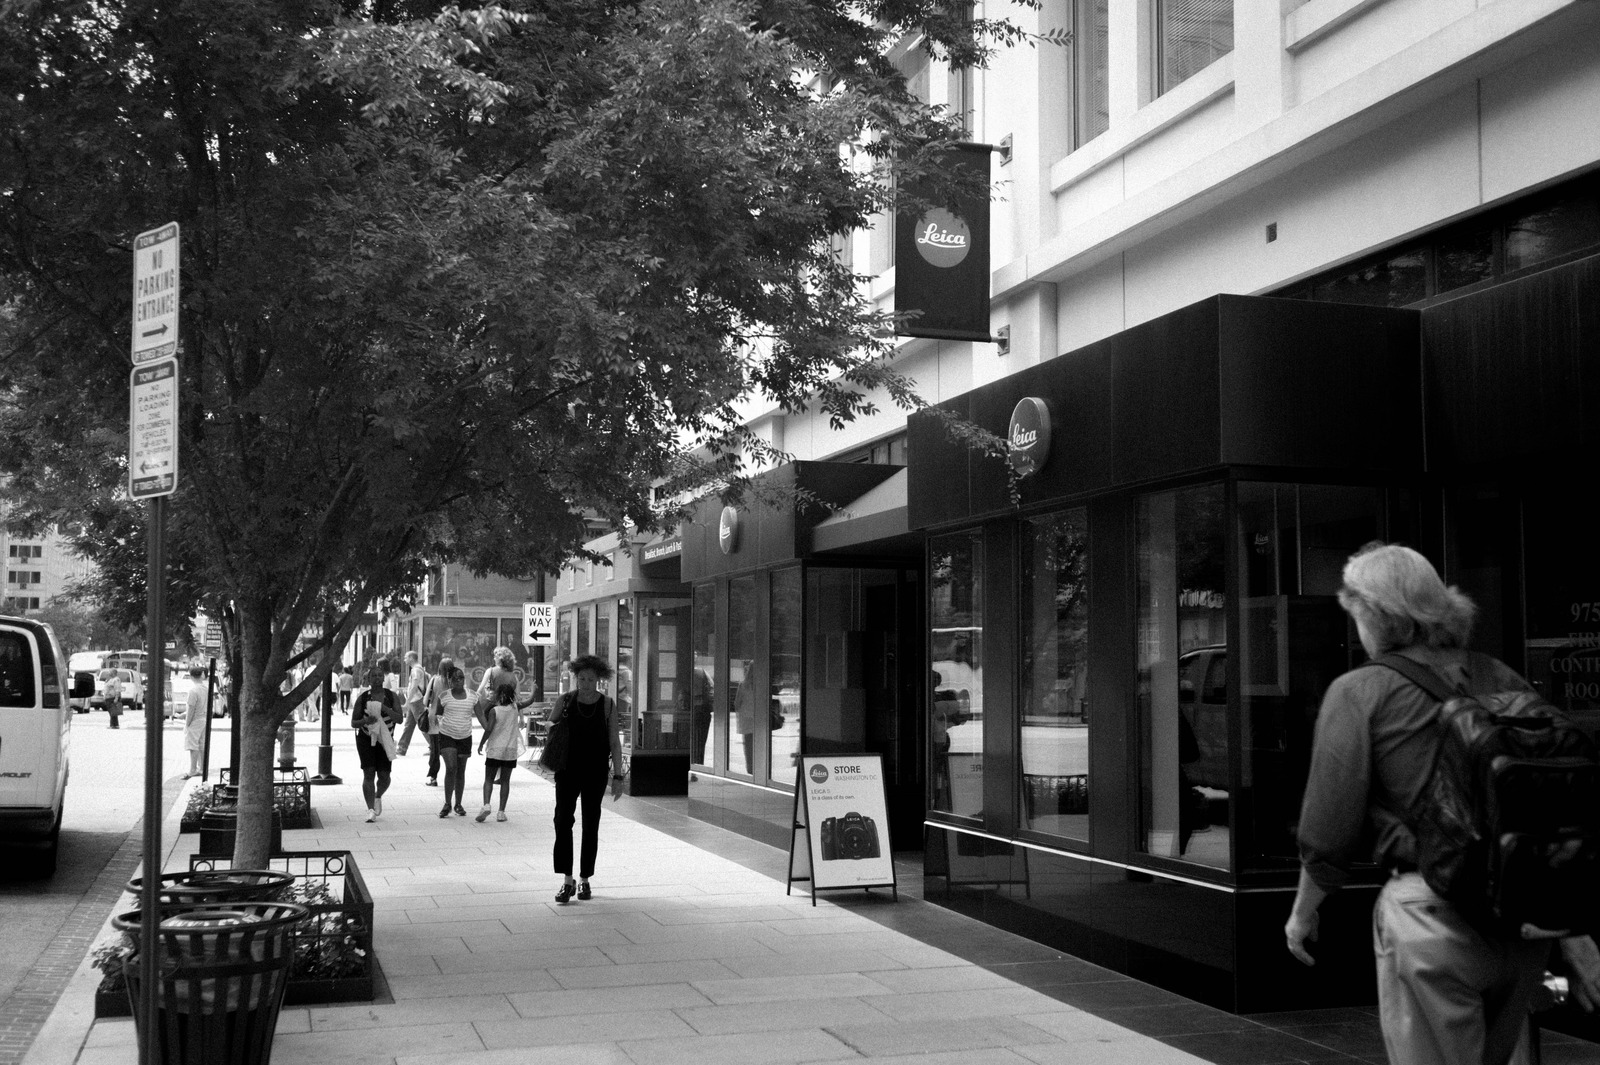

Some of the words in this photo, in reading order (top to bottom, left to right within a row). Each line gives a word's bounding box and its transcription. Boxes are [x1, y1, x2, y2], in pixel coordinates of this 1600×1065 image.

[139, 236, 154, 247] TOW
[917, 222, 966, 248] Leica
[153, 250, 162, 270] NO
[138, 269, 174, 298] PARKING
[138, 293, 174, 322] ENTRANCE
[139, 372, 153, 382] TOW
[138, 391, 171, 404] PARKING
[140, 400, 169, 413] LOADING
[1010, 423, 1038, 451] Leica
[530, 607, 551, 616] ONE
[529, 618, 552, 627] WAY
[811, 769, 828, 778] Leica
[834, 766, 861, 774] STORE
